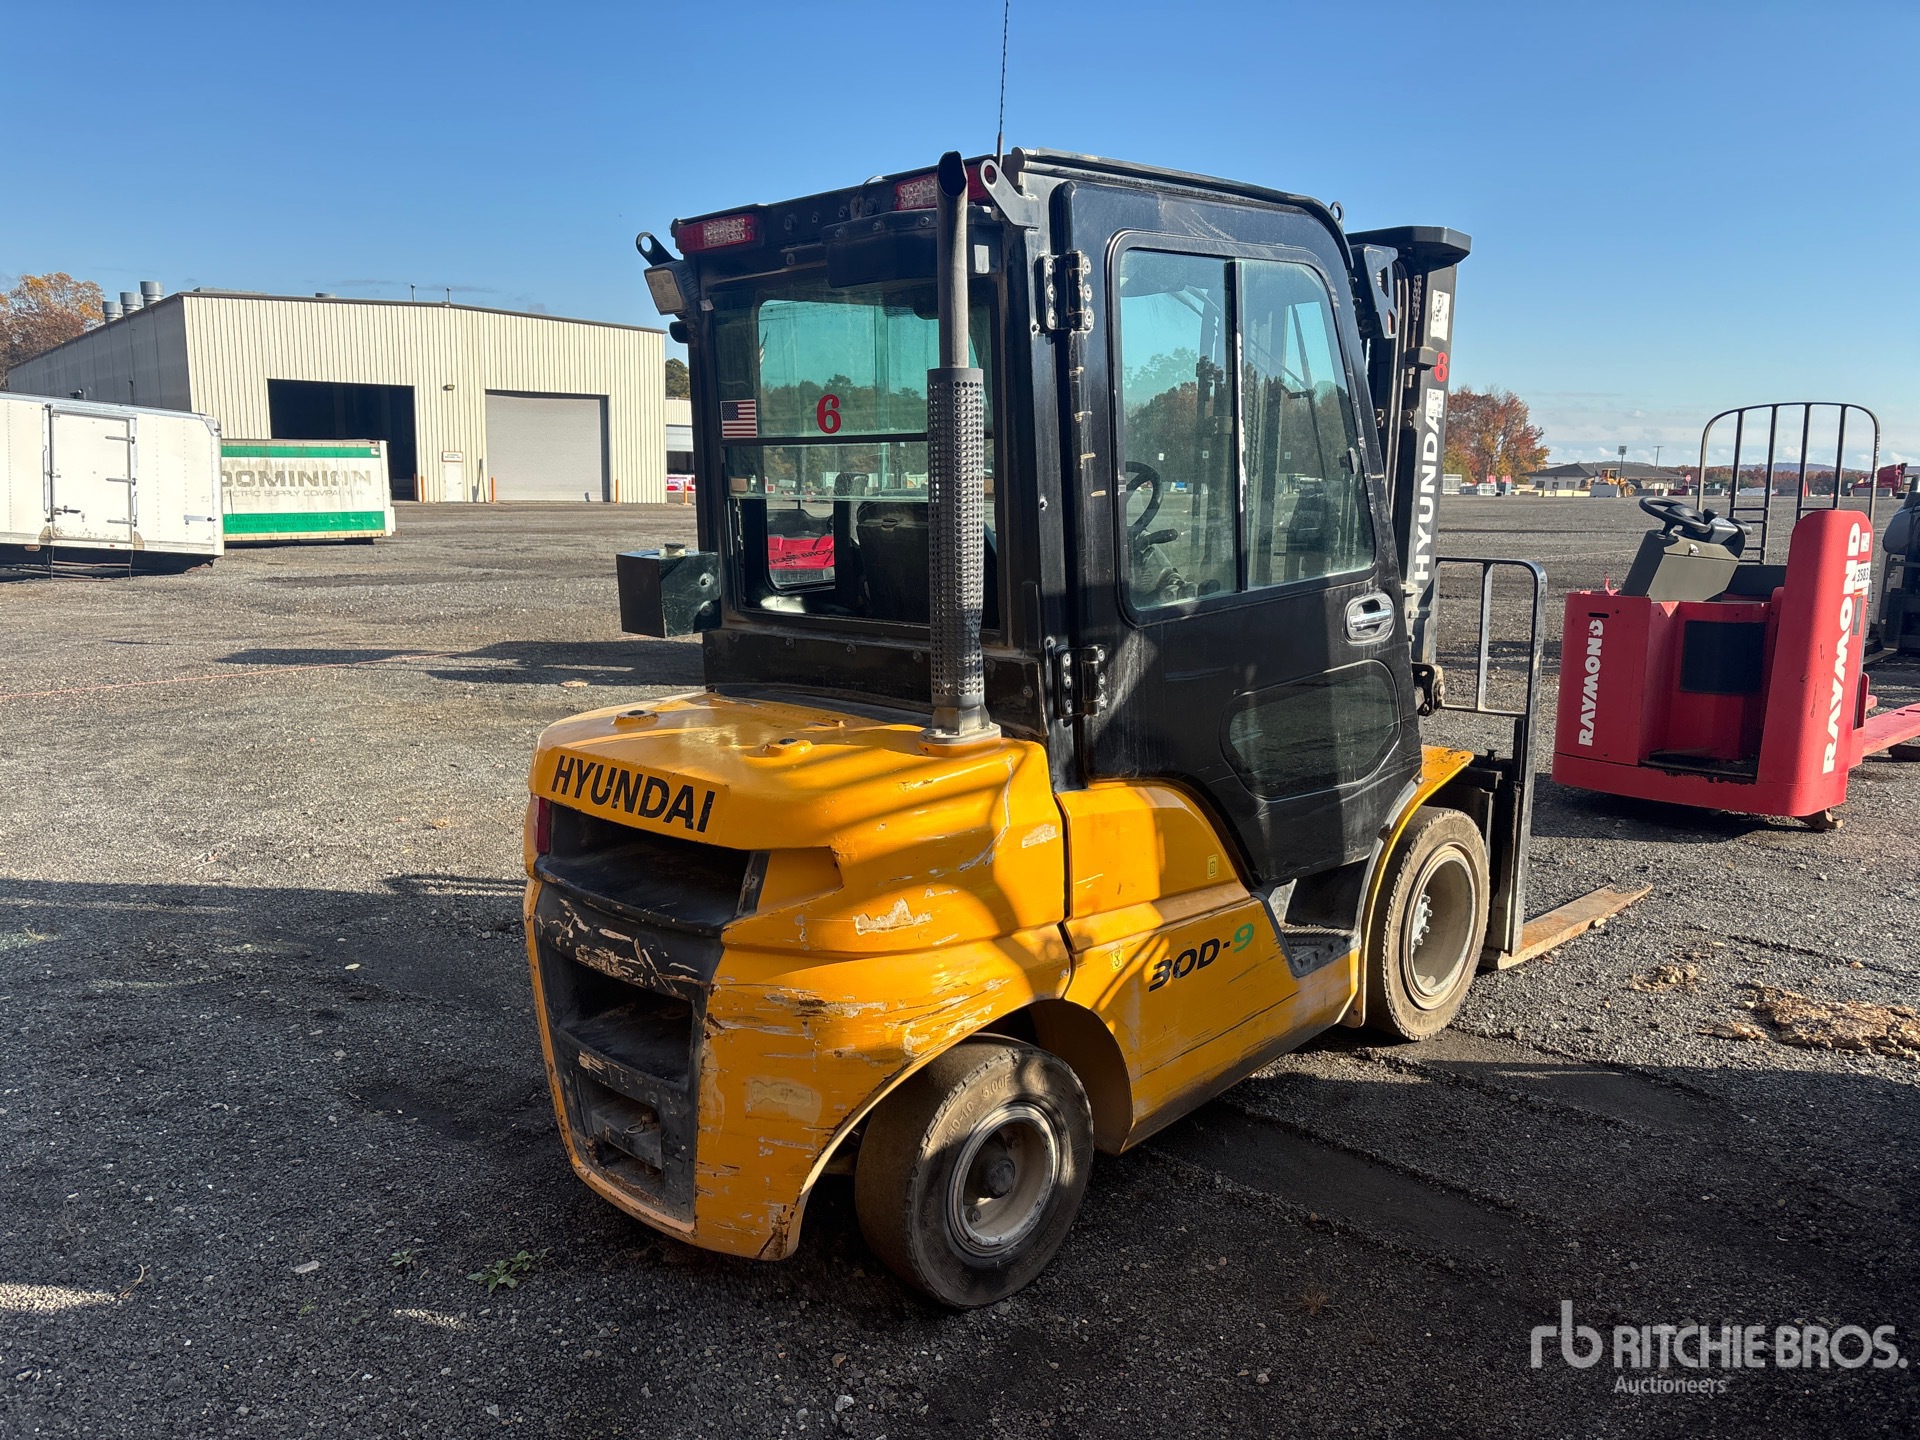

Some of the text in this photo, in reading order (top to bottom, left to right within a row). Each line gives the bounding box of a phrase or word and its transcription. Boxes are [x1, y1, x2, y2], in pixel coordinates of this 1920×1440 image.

[1434, 352, 1448, 382] 6
[816, 394, 842, 434] 6
[263, 489, 300, 497] SUPPLY
[1414, 412, 1440, 581] HYUNDA
[1822, 522, 1861, 774] RAYMOND
[550, 754, 716, 834] HYUNDAI
[1148, 922, 1255, 993] 30D-9
